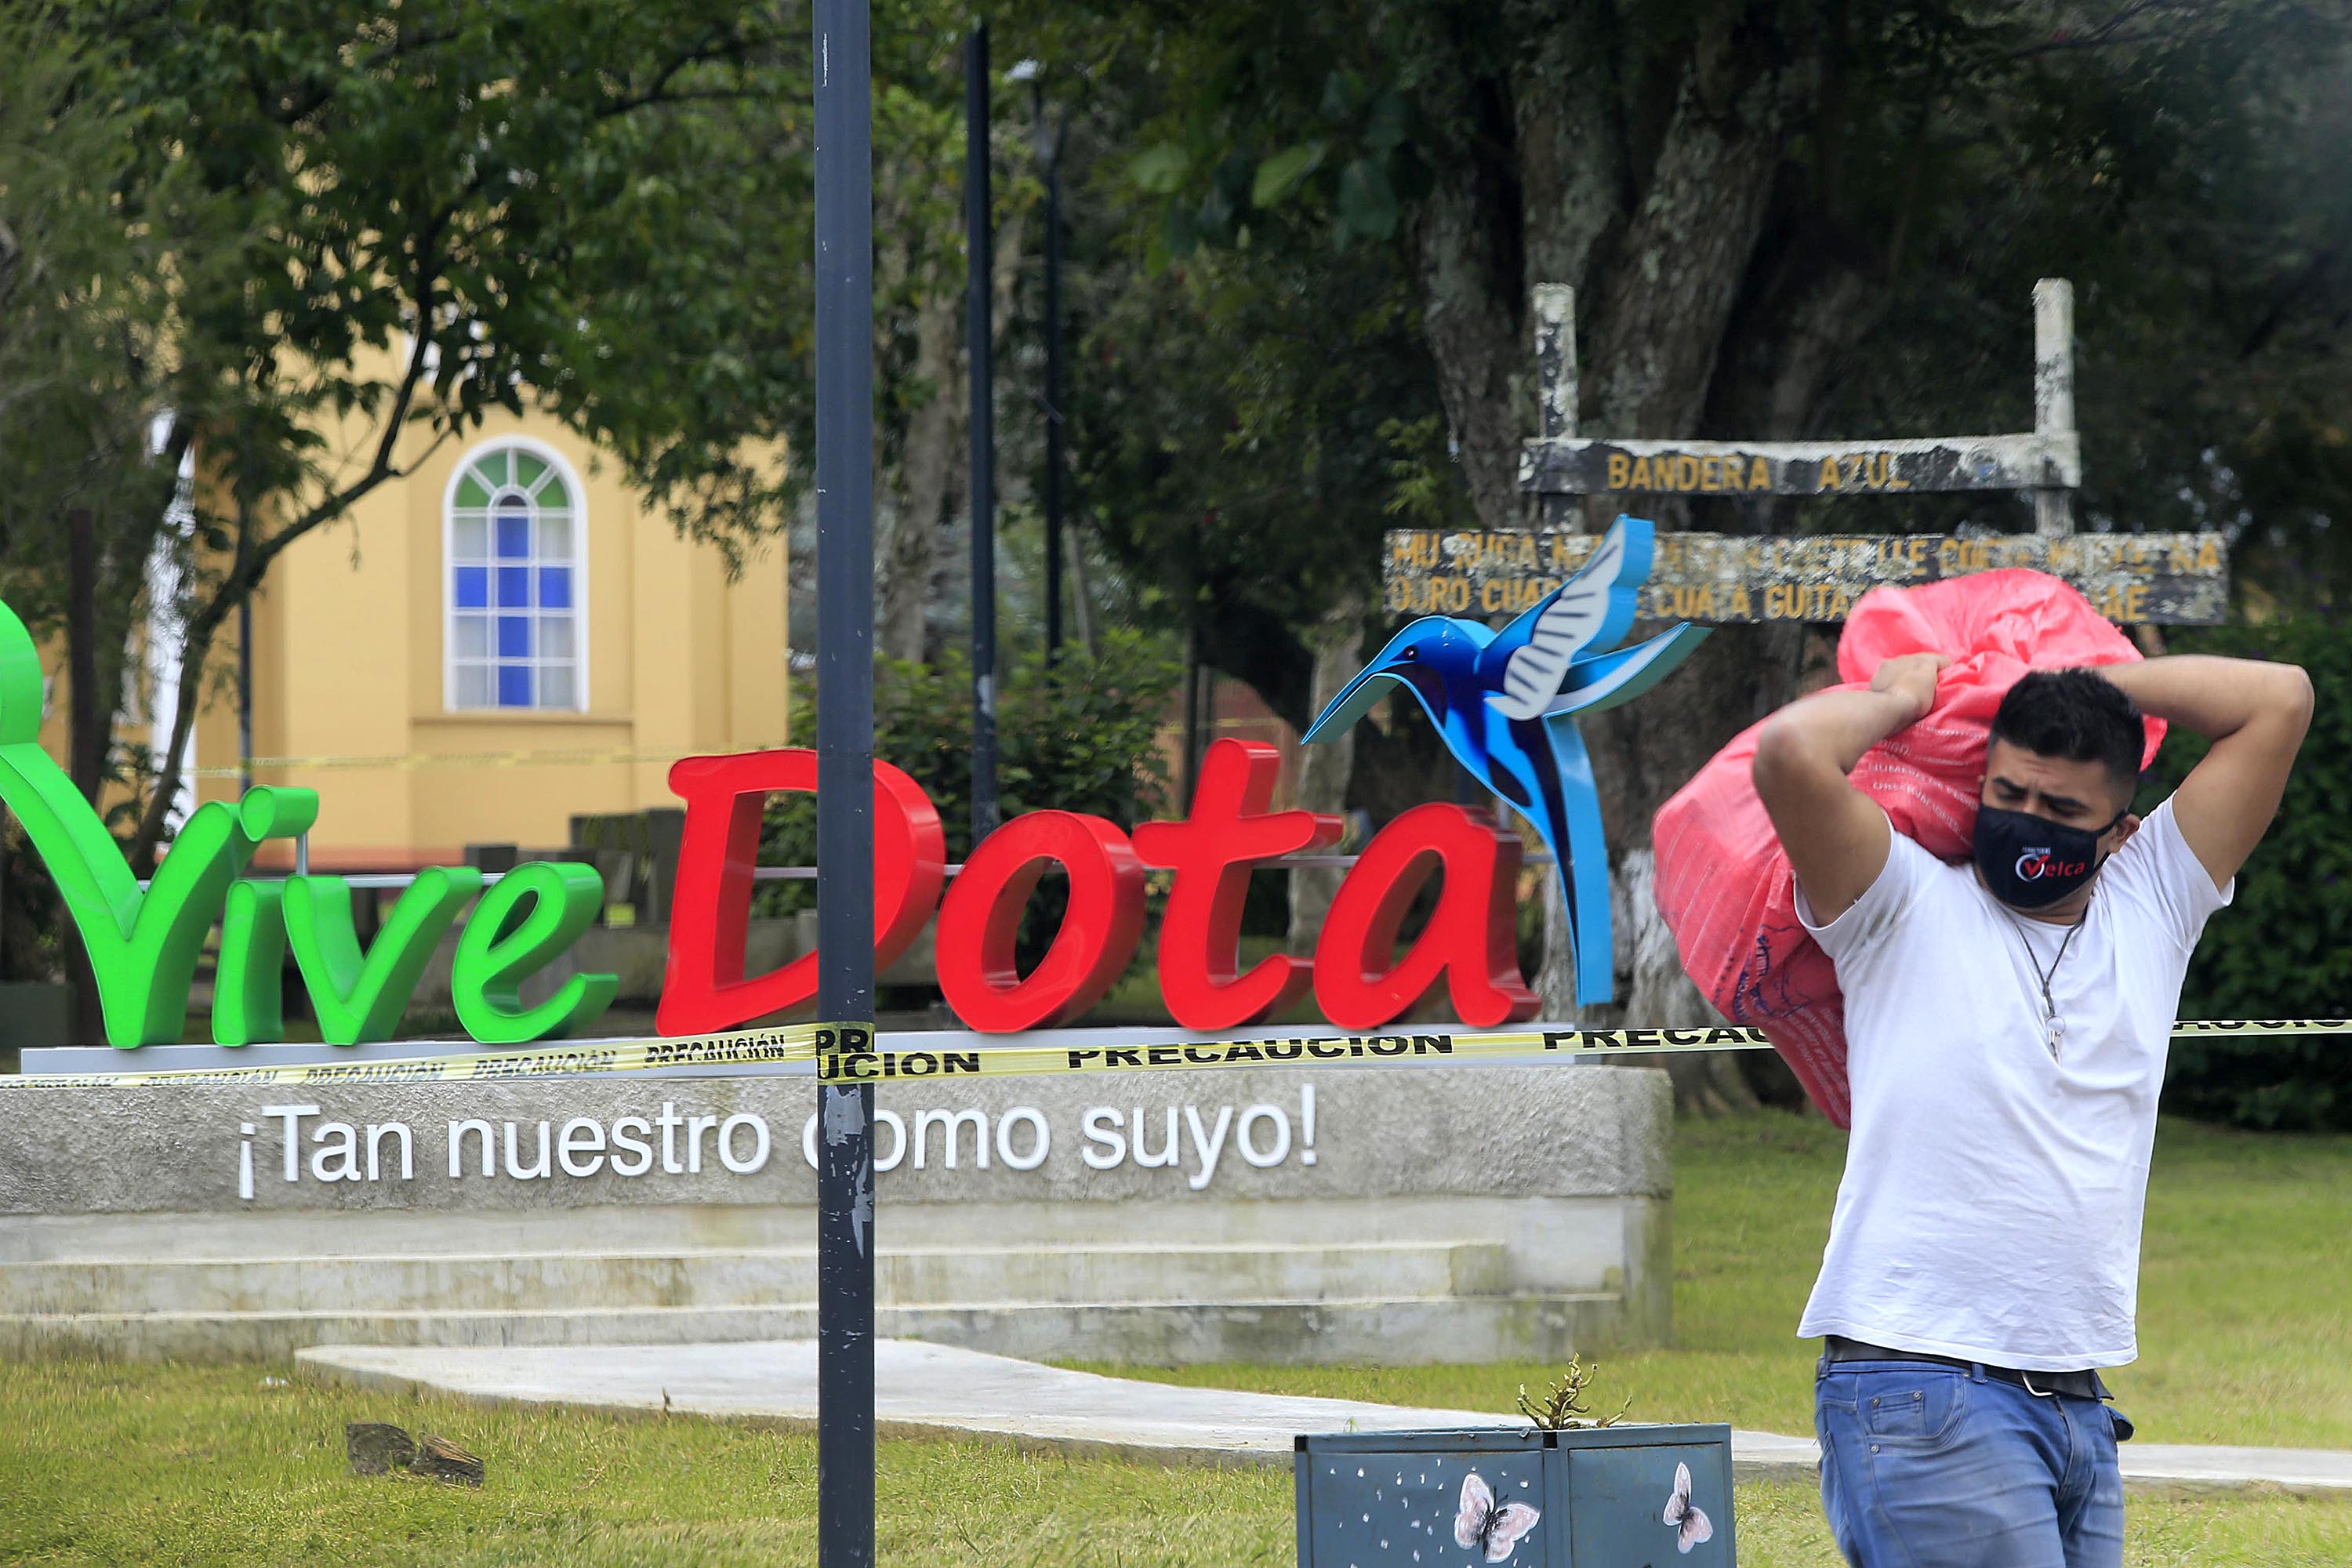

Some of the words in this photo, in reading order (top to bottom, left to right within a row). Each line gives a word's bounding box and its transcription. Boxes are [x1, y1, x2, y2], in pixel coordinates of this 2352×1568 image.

[1609, 452, 1773, 492] BANDERA
[1818, 452, 1910, 492] AZUL
[0, 599, 619, 1049] Vive
[655, 738, 1541, 1033] Dota
[2023, 855, 2085, 877] Velca
[815, 1029, 875, 1056] PR
[239, 1105, 414, 1200] ¡Tan
[448, 1101, 771, 1181] nuestro
[1081, 1082, 1318, 1191] suyo!
